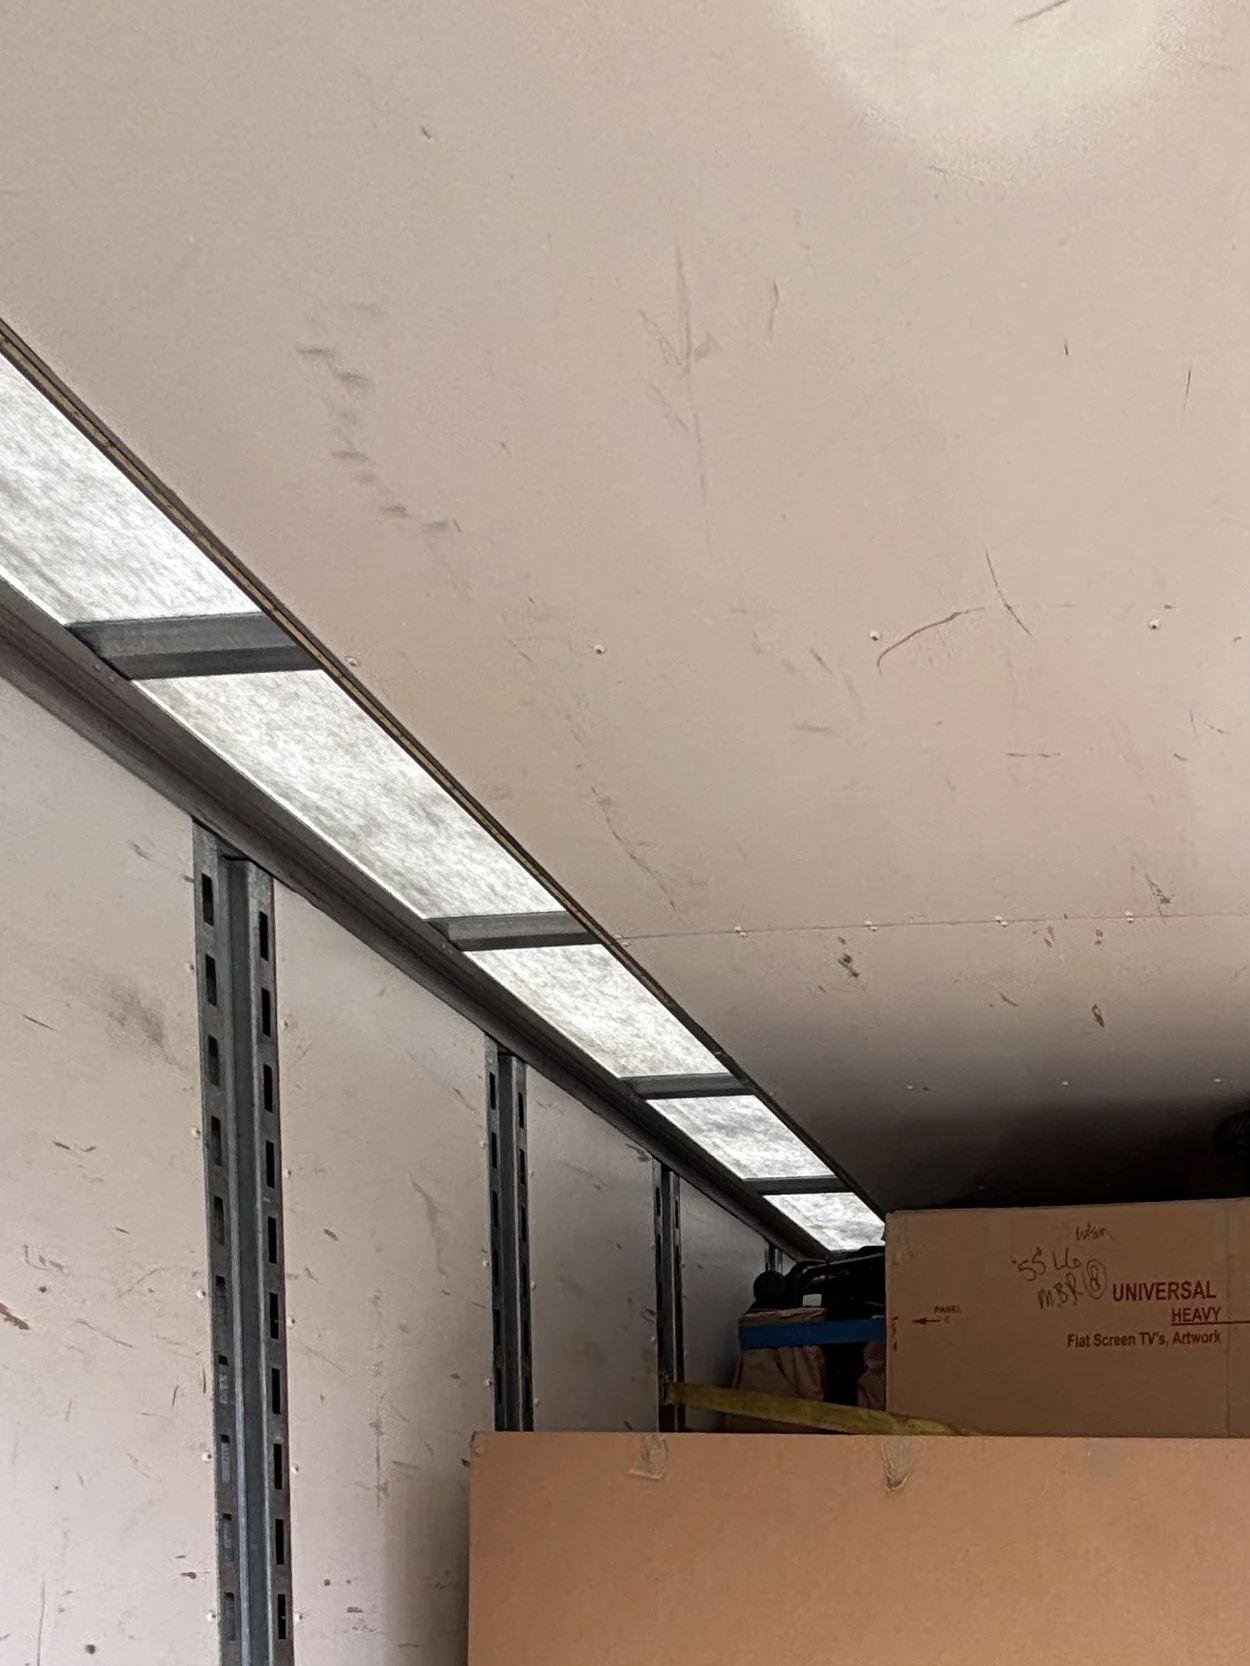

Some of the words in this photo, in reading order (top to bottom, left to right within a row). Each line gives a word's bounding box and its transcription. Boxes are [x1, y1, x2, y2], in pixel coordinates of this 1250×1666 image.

[1112, 1280, 1217, 1301] UNIVERSAL
[1171, 1306, 1221, 1322] HEAVY
[1067, 1333, 1091, 1348] Flat
[1093, 1333, 1136, 1347] Screen
[1172, 1330, 1221, 1345] Artwork
